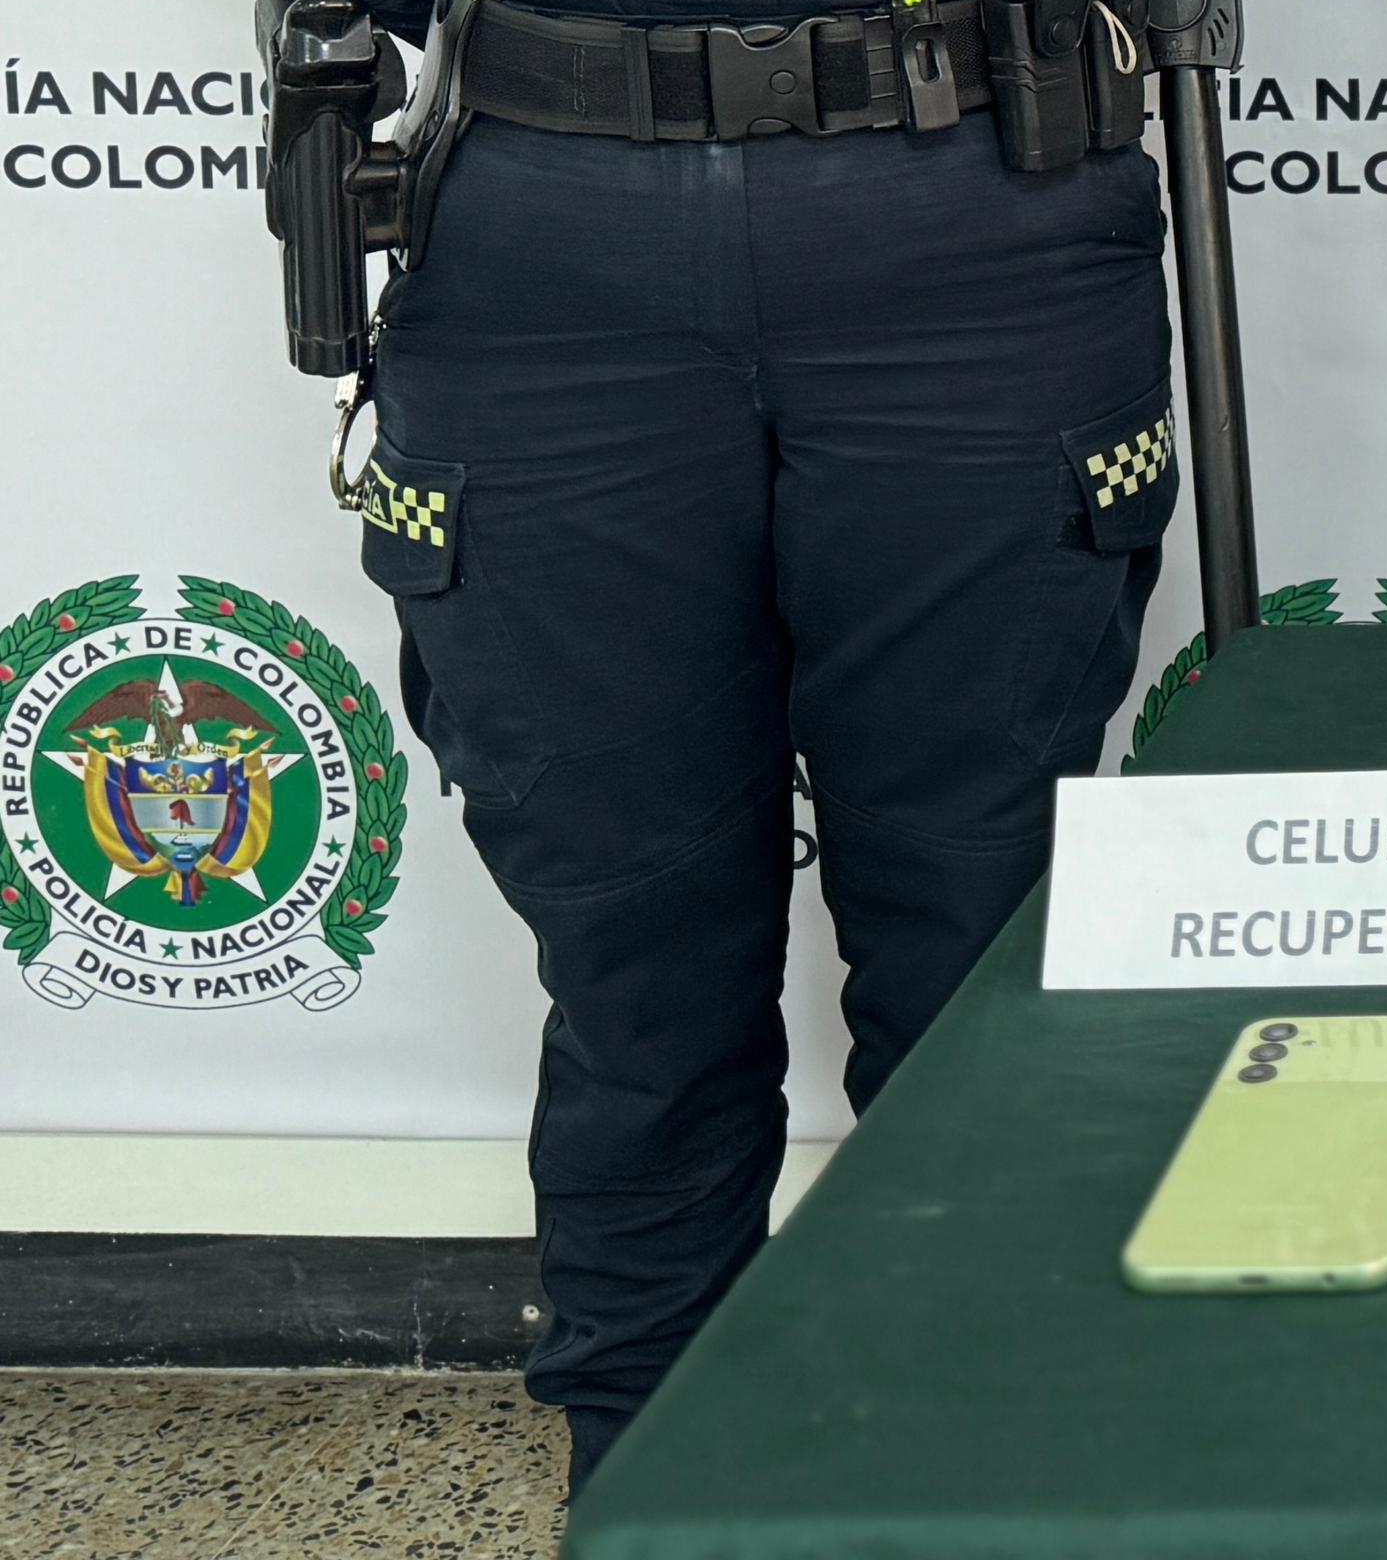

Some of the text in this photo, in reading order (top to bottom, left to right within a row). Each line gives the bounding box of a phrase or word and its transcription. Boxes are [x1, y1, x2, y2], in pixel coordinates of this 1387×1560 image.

[3, 143, 267, 190] COLOM
[1, 625, 351, 822] REPÚBLICA DE COLOMBIA
[28, 857, 341, 961] POLICÍA NACIONAL
[73, 947, 310, 1001] DIOS Y PATRIA
